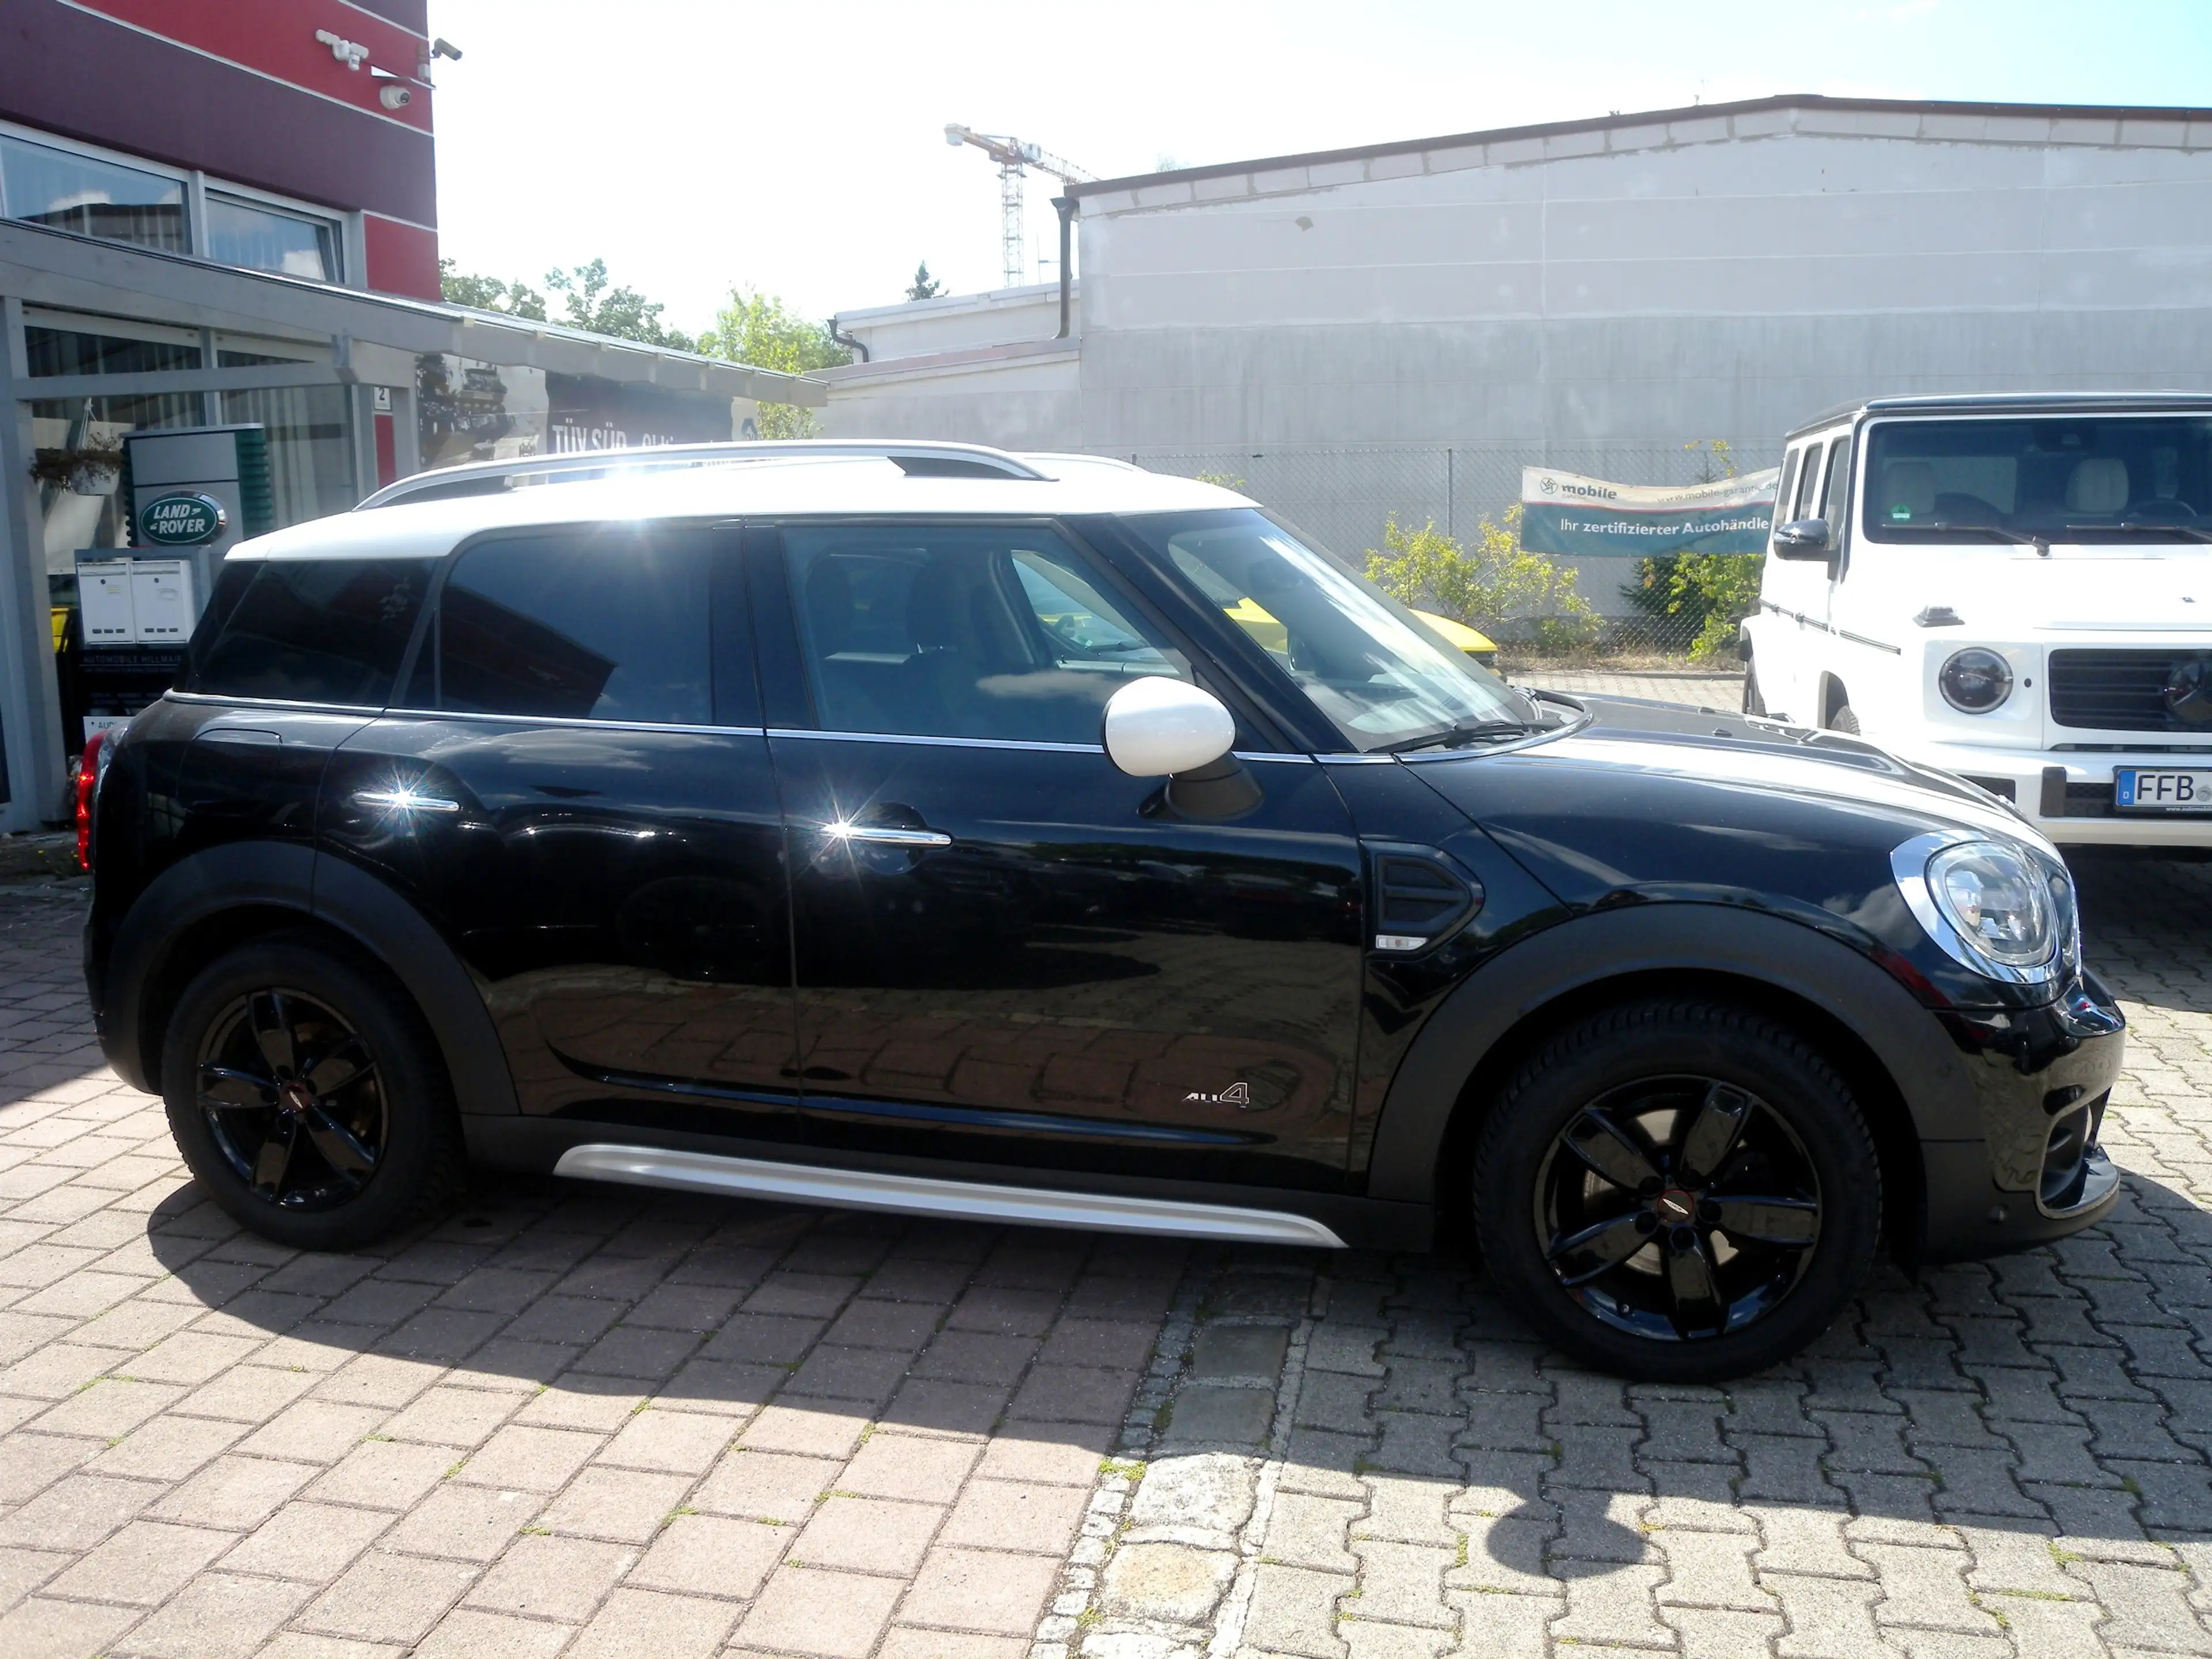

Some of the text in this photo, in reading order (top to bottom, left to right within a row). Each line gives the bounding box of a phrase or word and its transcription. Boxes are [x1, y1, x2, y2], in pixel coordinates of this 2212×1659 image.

[378, 387, 385, 401] 2
[552, 418, 587, 454] TÜV
[1562, 484, 1617, 499] mobile
[154, 505, 190, 519] LAND
[159, 519, 205, 535] ROVER
[1560, 517, 1771, 535] Ihr zertifizierter Autohändle
[2123, 791, 2130, 799] D
[2137, 775, 2194, 801] FFB
